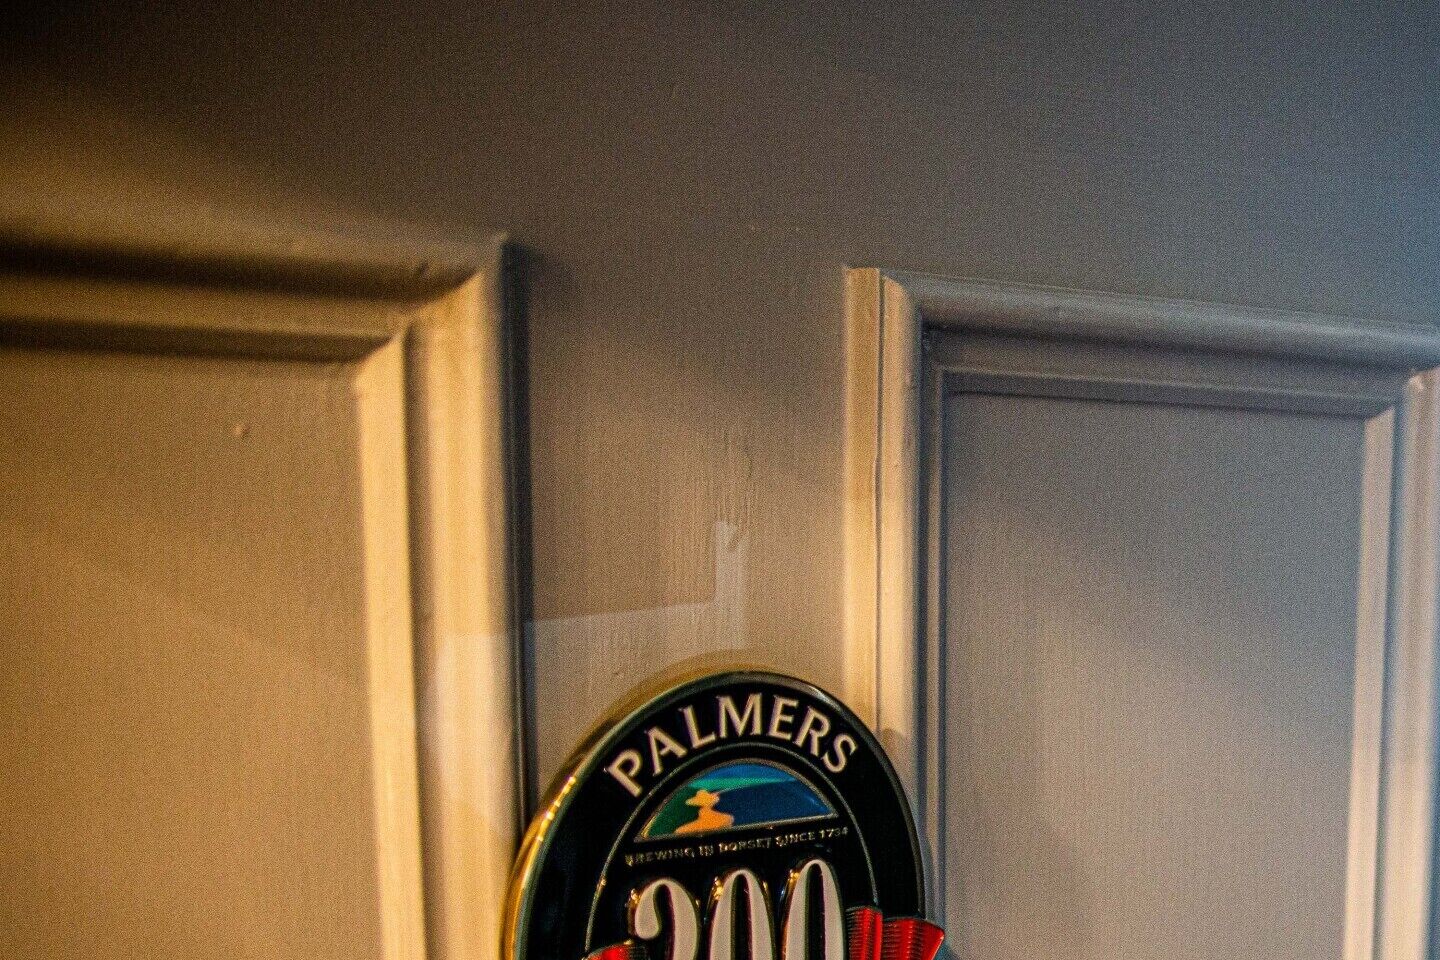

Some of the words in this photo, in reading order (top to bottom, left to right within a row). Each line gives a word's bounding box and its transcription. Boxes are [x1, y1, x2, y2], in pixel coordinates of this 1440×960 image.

[604, 692, 858, 797] PALMERS
[698, 845, 714, 857] IN
[718, 837, 772, 852] DORSET
[775, 831, 816, 847] SINCE
